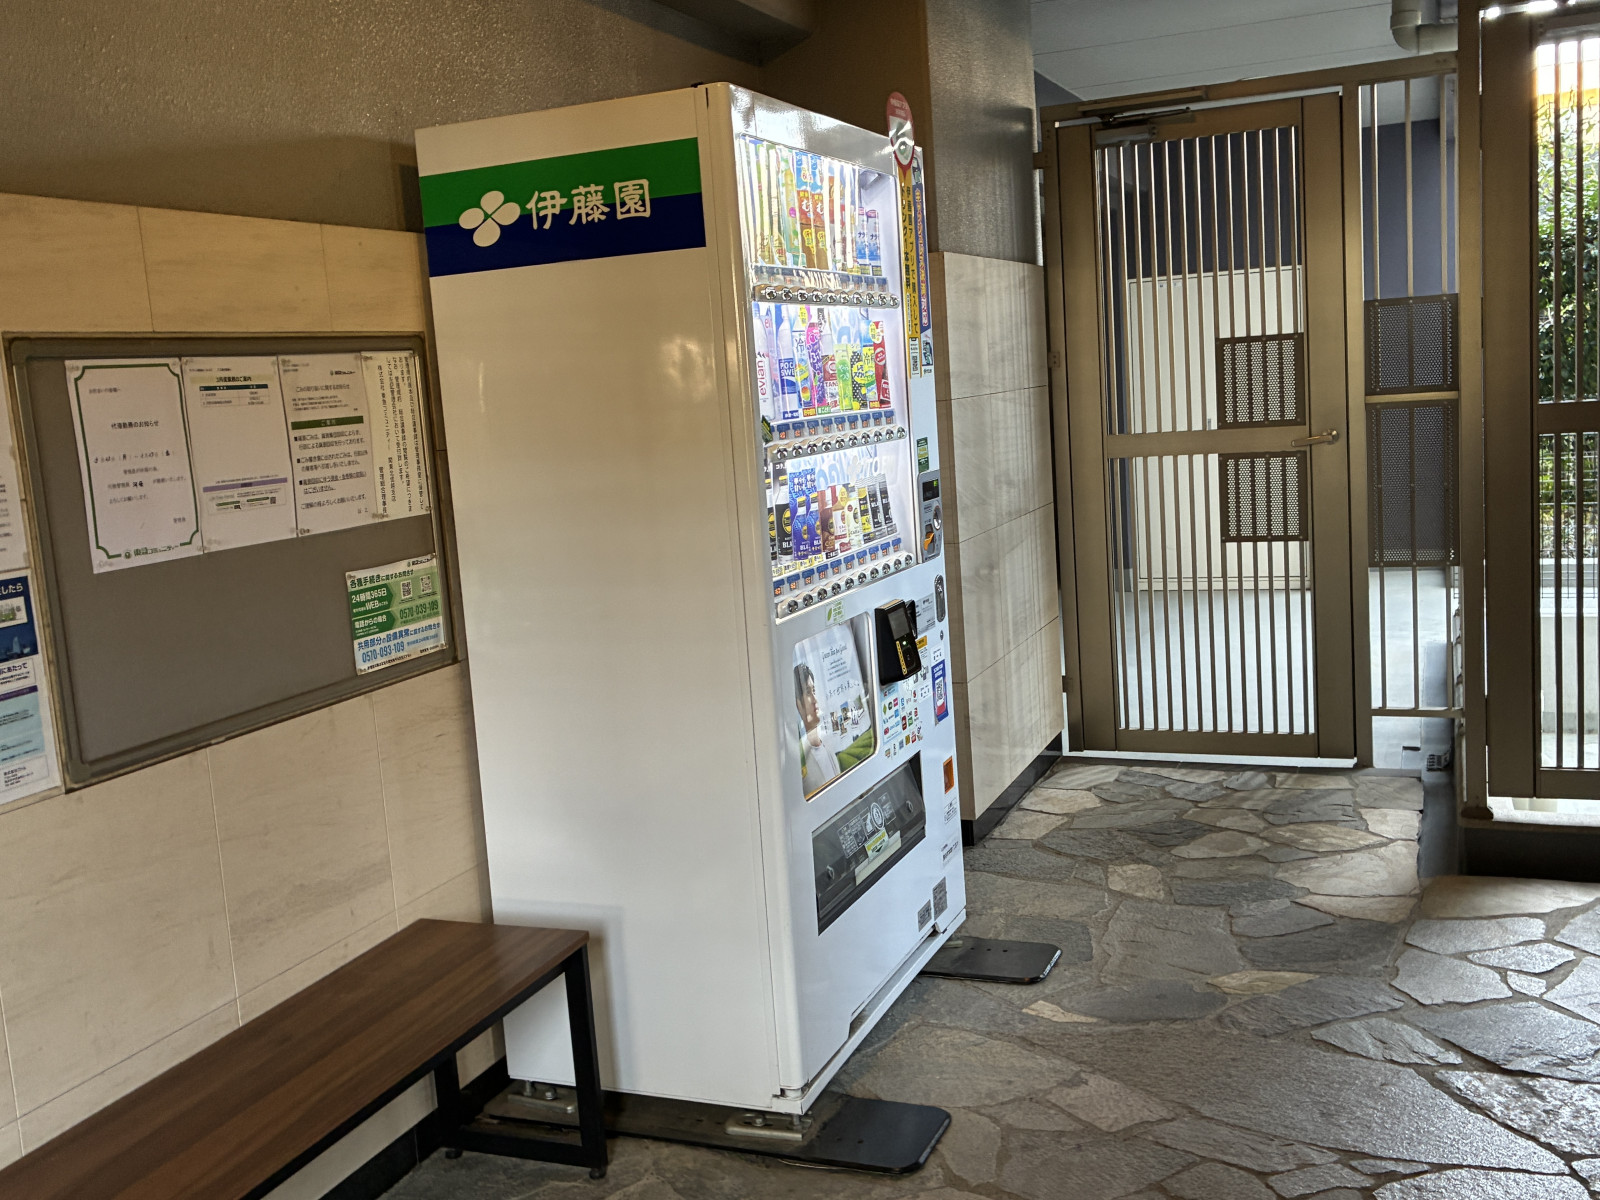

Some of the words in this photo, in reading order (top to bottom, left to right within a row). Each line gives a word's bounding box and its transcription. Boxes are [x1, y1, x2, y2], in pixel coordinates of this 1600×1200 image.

[525, 178, 651, 230] 伊藤園
[757, 360, 767, 396] evian
[0, 583, 23, 596] したら
[351, 587, 387, 603] 24時間365日
[399, 599, 439, 620] 0570-039-109
[362, 641, 405, 663] 0570-093-109
